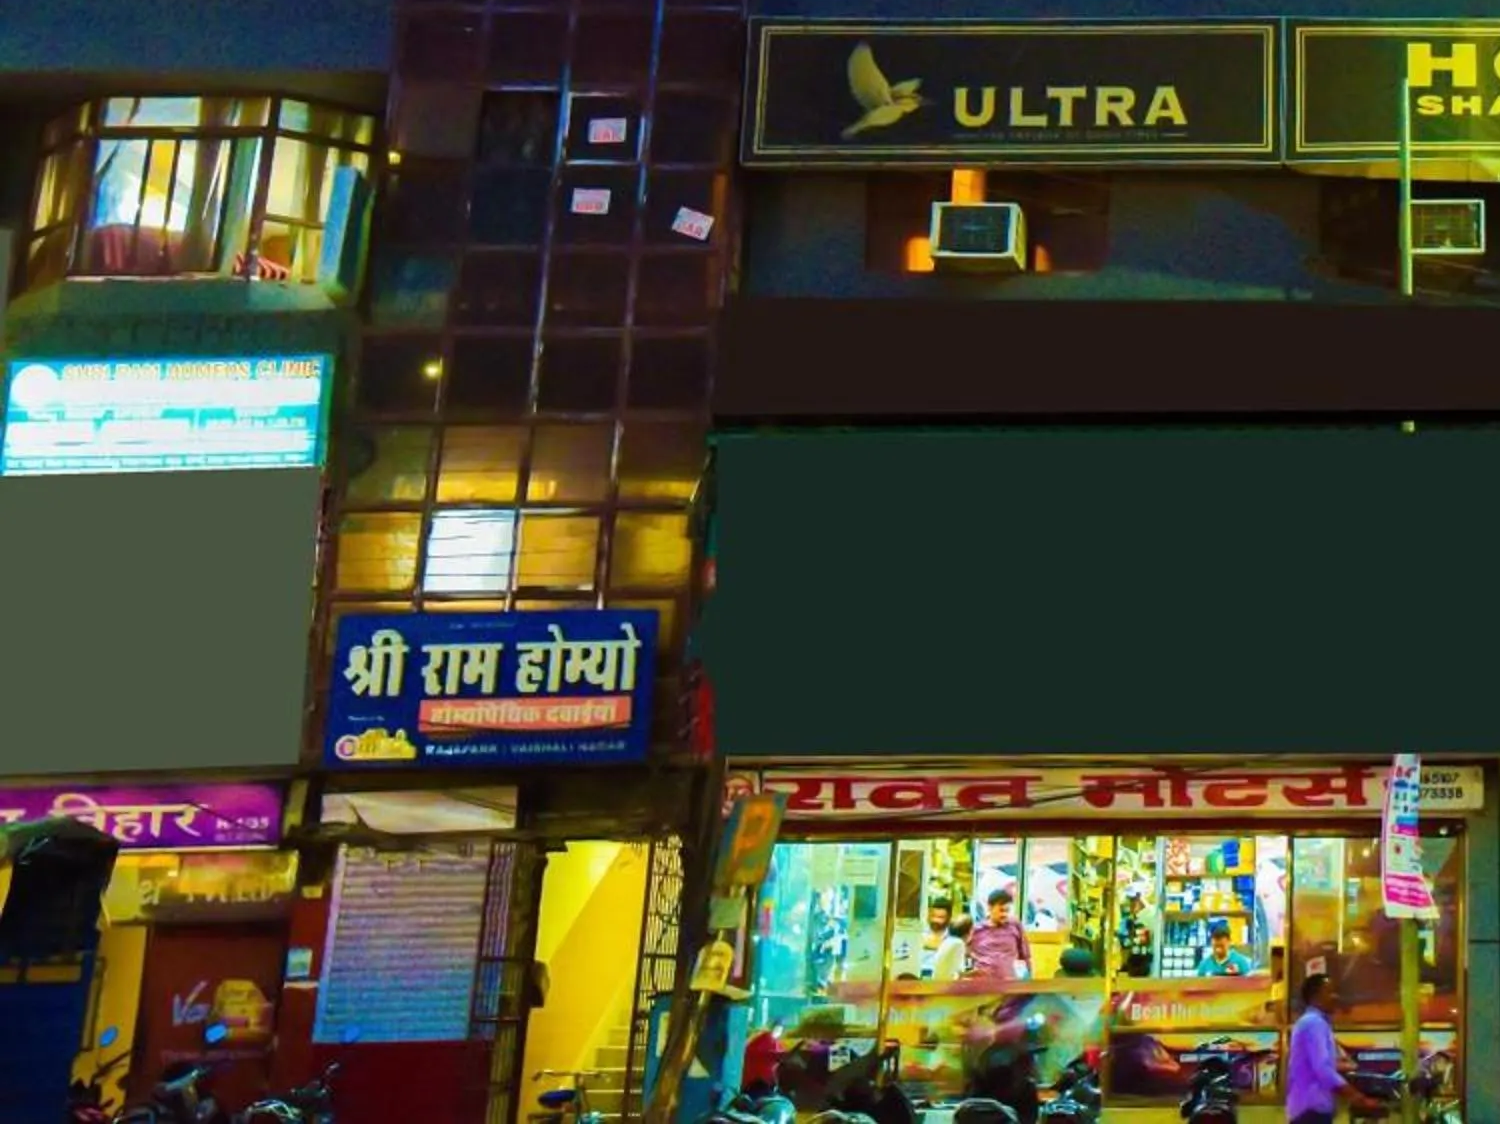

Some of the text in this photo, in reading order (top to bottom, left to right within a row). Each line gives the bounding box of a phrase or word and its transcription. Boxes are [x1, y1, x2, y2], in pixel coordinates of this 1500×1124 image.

[954, 86, 1188, 127] ULTRA
[344, 622, 642, 697] श्री राम होम्यो
[763, 775, 1043, 810] रावत
